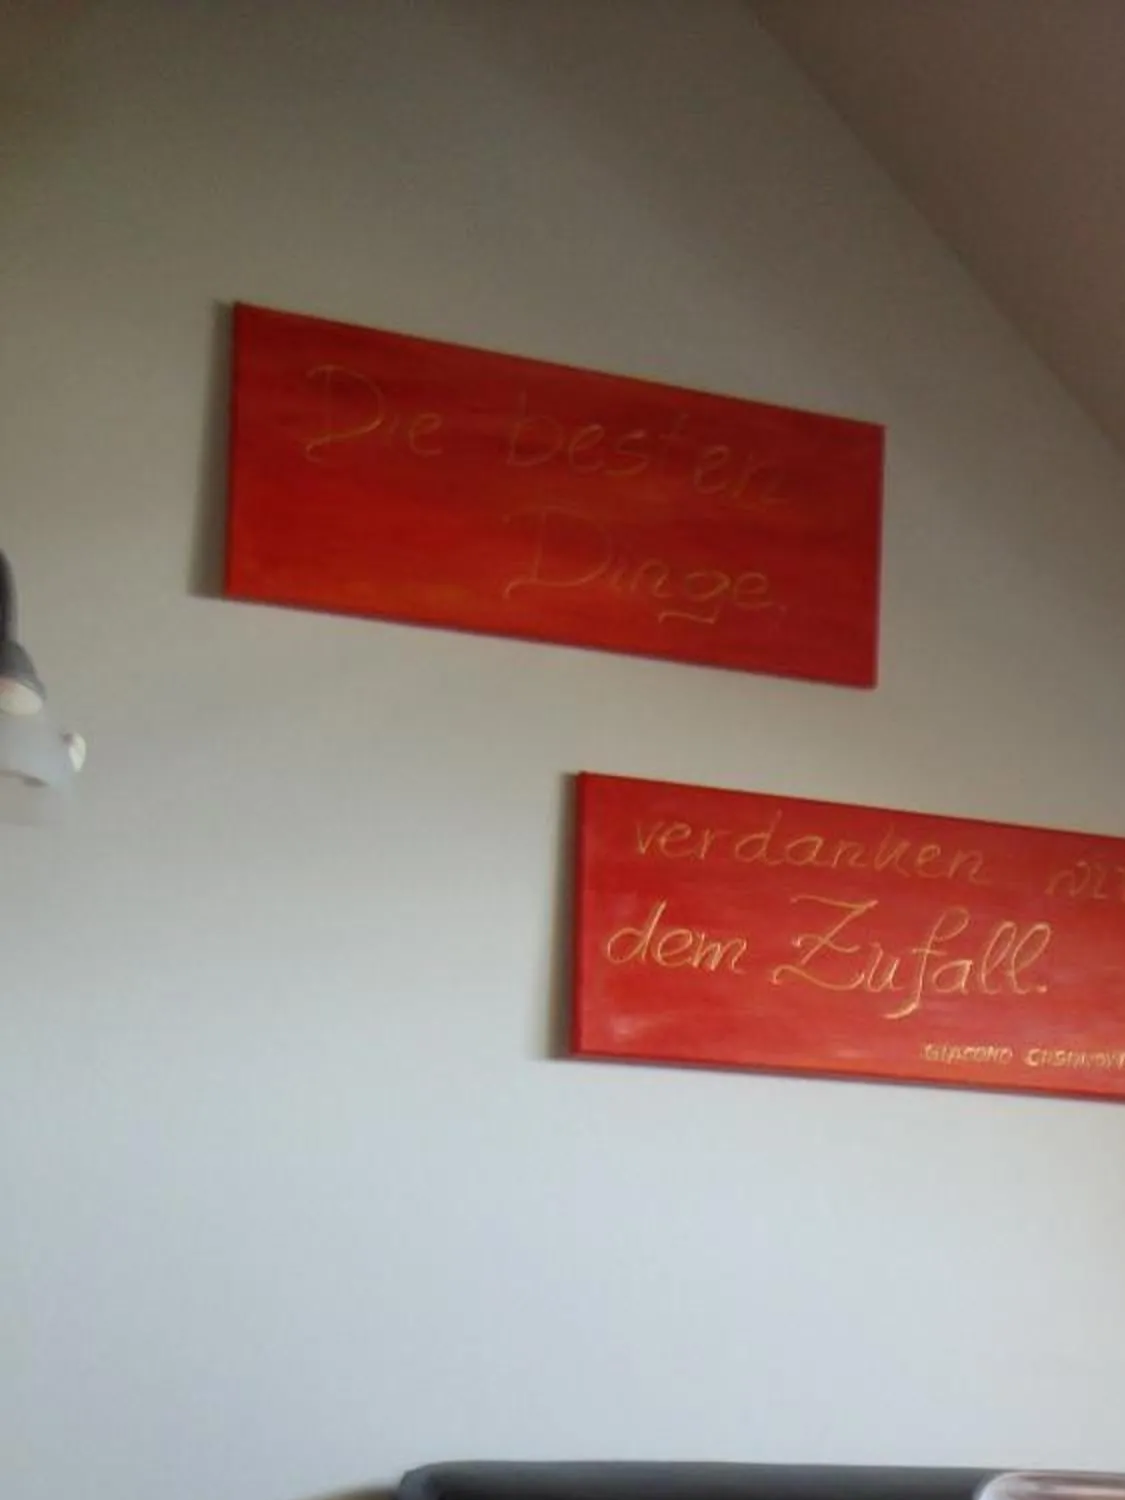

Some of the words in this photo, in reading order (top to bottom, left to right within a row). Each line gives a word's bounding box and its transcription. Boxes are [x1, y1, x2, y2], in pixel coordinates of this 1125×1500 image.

[303, 363, 443, 464] Die
[506, 387, 790, 511] besten
[634, 809, 992, 886] verdanken
[606, 900, 748, 972] dem
[771, 893, 1051, 1019] Zufall.
